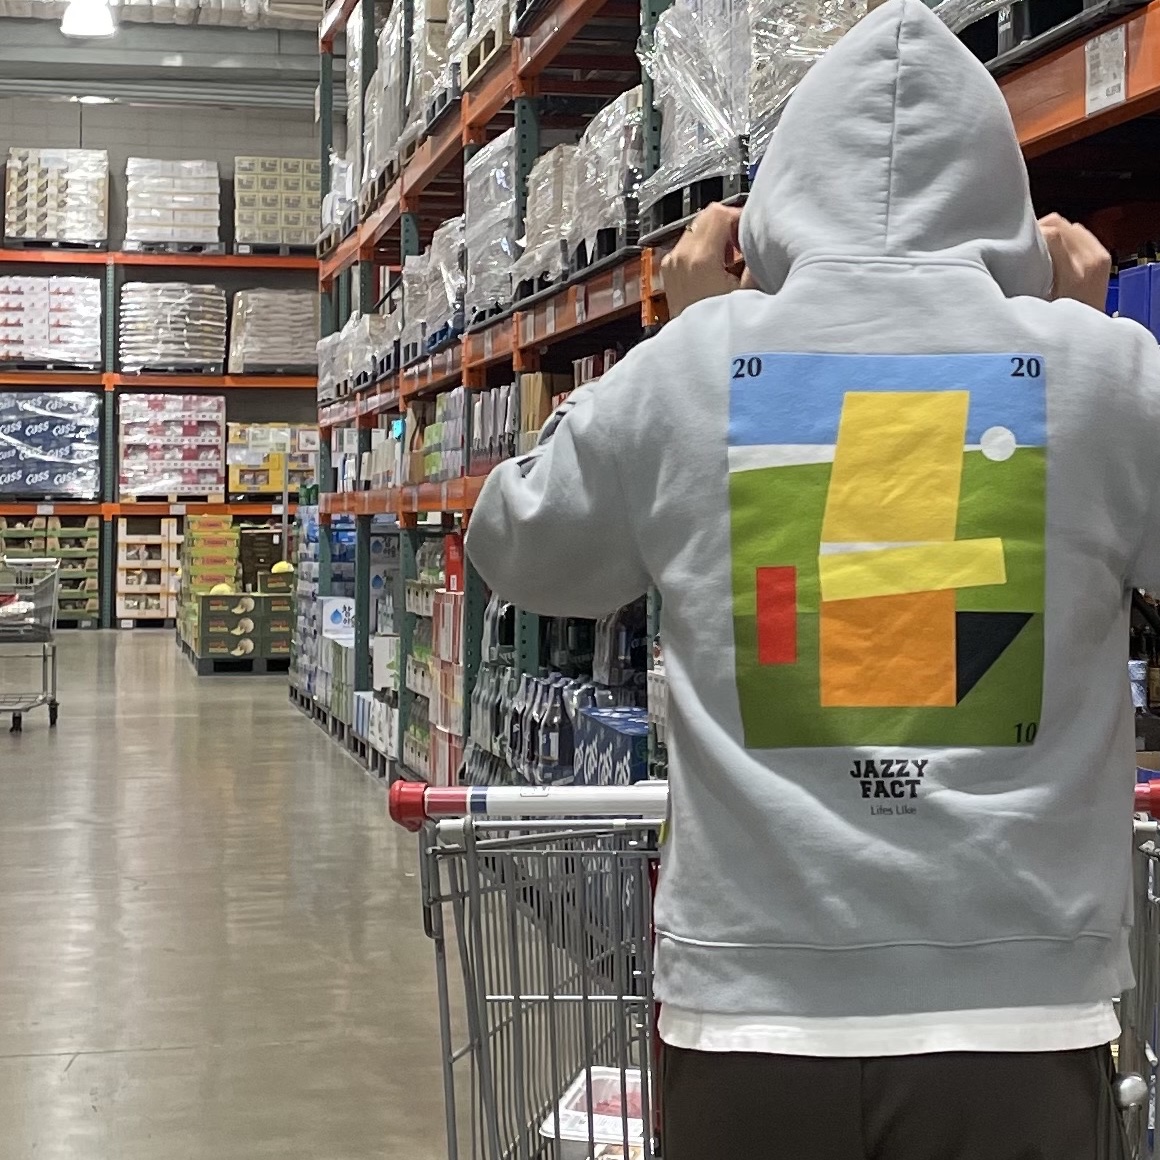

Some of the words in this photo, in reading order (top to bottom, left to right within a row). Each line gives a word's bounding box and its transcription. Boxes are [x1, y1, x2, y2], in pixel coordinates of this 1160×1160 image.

[732, 356, 763, 379] 20
[1010, 357, 1041, 378] 20
[1014, 722, 1038, 745] 10
[850, 759, 928, 778] JAZZY
[860, 779, 921, 798] FACT
